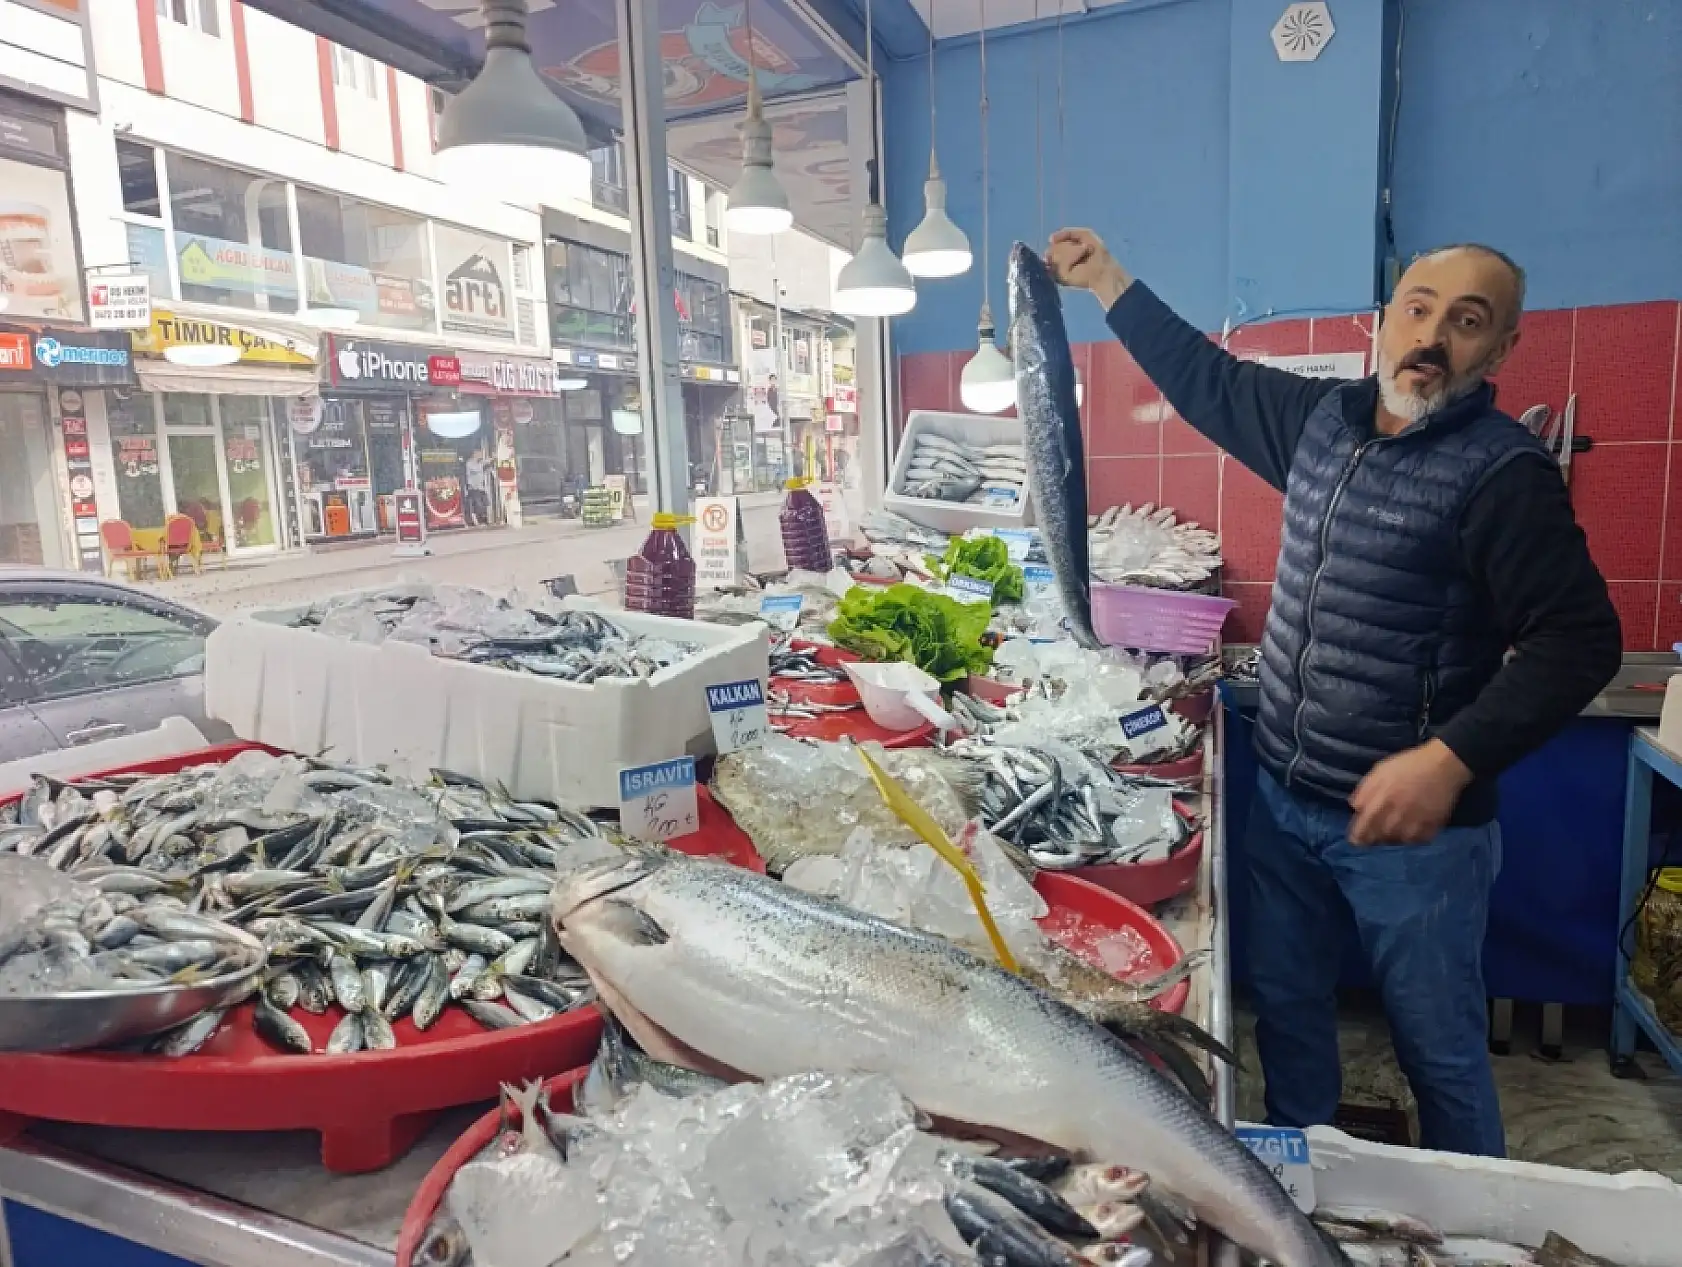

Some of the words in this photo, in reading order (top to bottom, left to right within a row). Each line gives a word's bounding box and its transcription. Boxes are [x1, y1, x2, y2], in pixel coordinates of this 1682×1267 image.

[157, 318, 233, 346] TİMUR
[361, 352, 429, 383] iPhone
[709, 683, 761, 706] KALKAN
